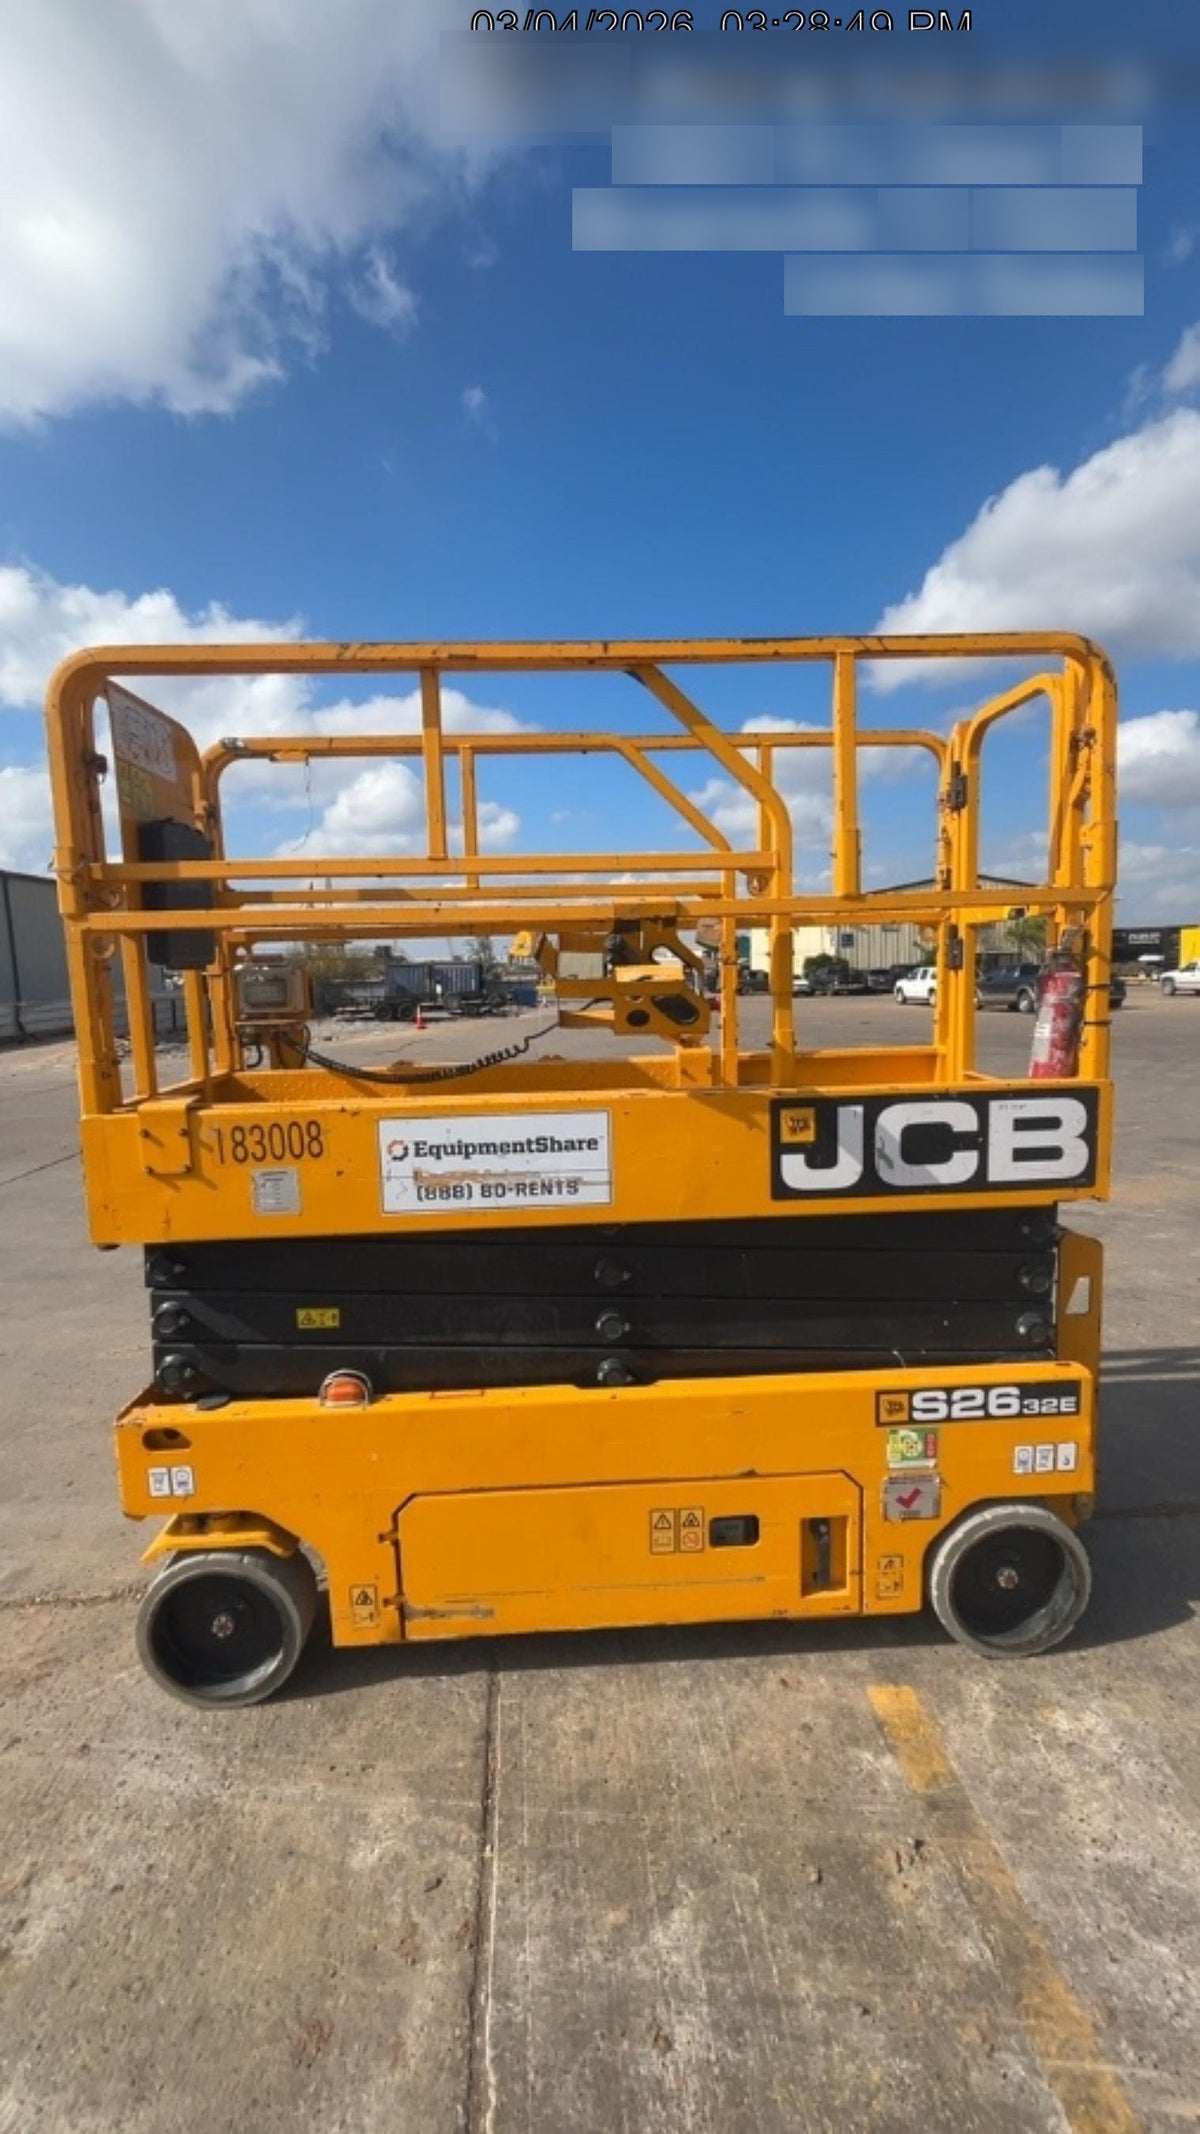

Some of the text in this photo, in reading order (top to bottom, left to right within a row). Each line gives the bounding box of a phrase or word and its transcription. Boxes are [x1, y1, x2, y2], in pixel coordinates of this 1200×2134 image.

[215, 1120, 323, 1165] 183008
[413, 1136, 599, 1160] EquipmentShare
[781, 1097, 1089, 1190] JCB
